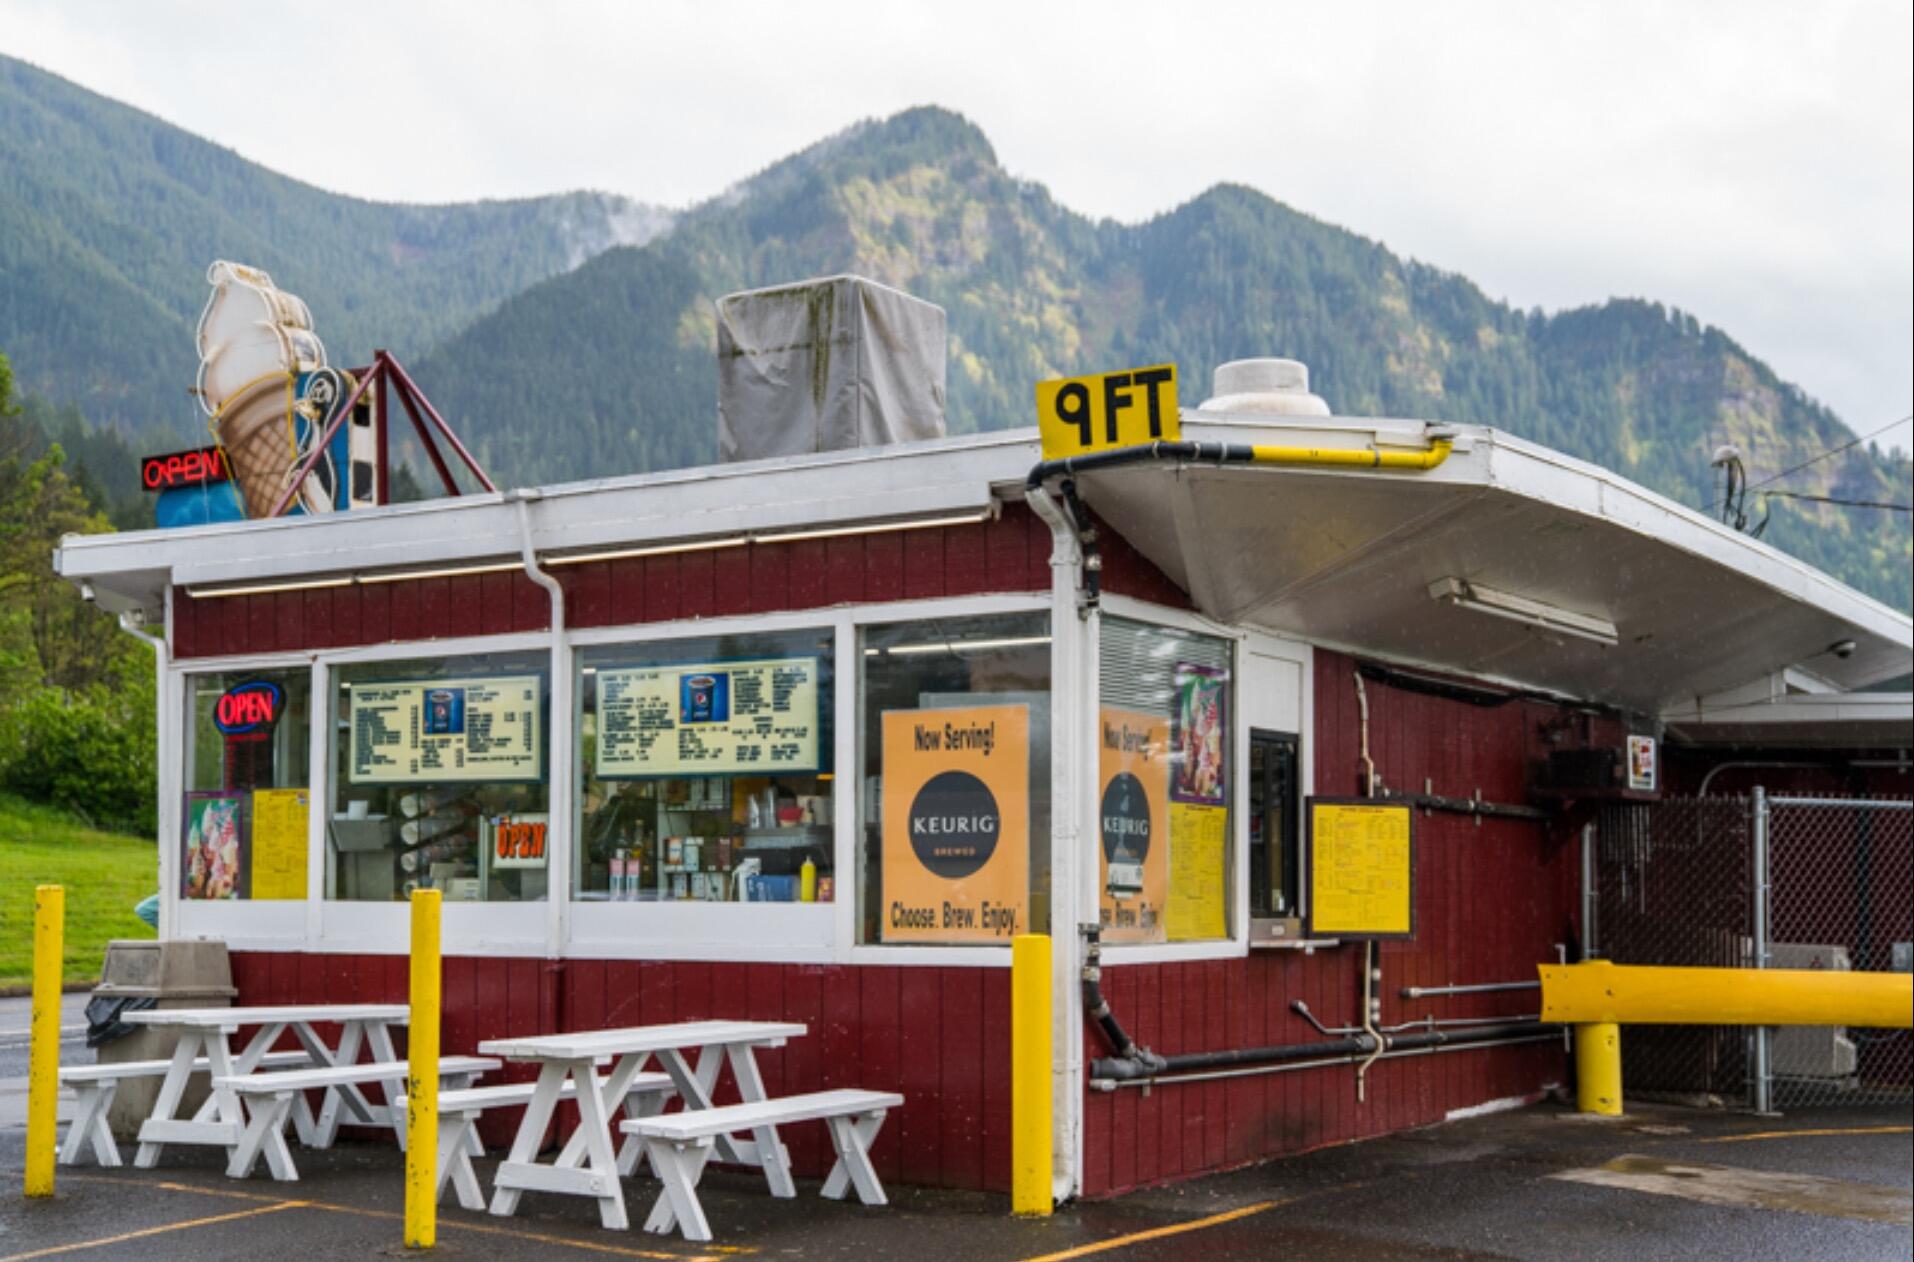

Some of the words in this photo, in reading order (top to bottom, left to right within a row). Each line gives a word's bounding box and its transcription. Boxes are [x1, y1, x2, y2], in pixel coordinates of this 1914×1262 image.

[1055, 382, 1092, 446] 9
[1104, 368, 1172, 443] FT
[143, 450, 219, 488] OPEN
[218, 691, 273, 725] OPEN
[914, 724, 941, 751] Now
[944, 721, 995, 756] Serving!
[497, 822, 545, 858] OPEN
[913, 815, 995, 835] KEURIG
[1103, 816, 1149, 836] KEURIG
[890, 900, 939, 929] Choose.
[943, 901, 978, 929] Brew.
[981, 900, 1019, 937] Enjoy.
